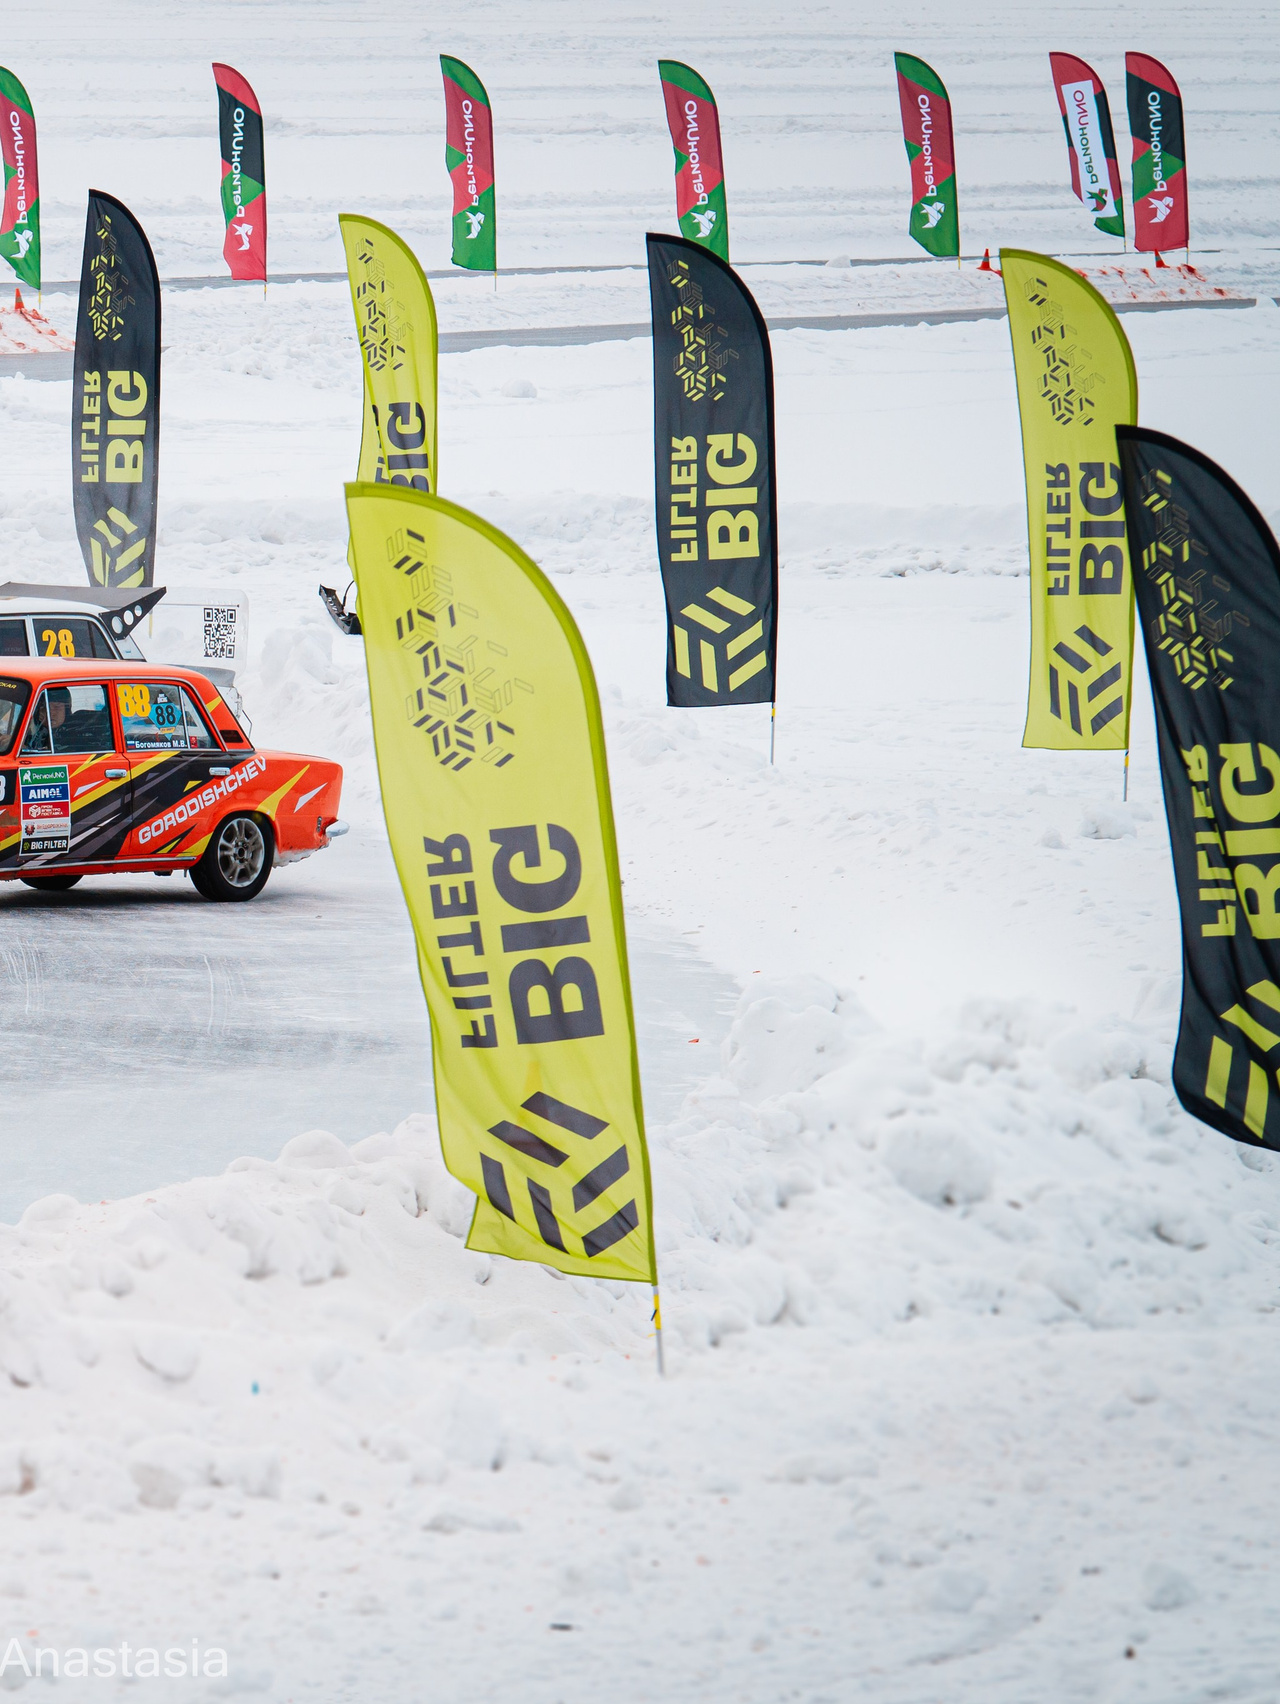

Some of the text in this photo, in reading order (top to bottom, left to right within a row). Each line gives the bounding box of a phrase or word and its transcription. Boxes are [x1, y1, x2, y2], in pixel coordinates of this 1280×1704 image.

[42, 629, 75, 657] 28
[117, 684, 152, 717] 88
[155, 704, 176, 725] 88
[135, 740, 172, 748] Богомяков
[29, 787, 63, 800] AIMOL
[138, 756, 267, 844] GORODISHCHEV
[30, 839, 68, 850] BIG FILTER
